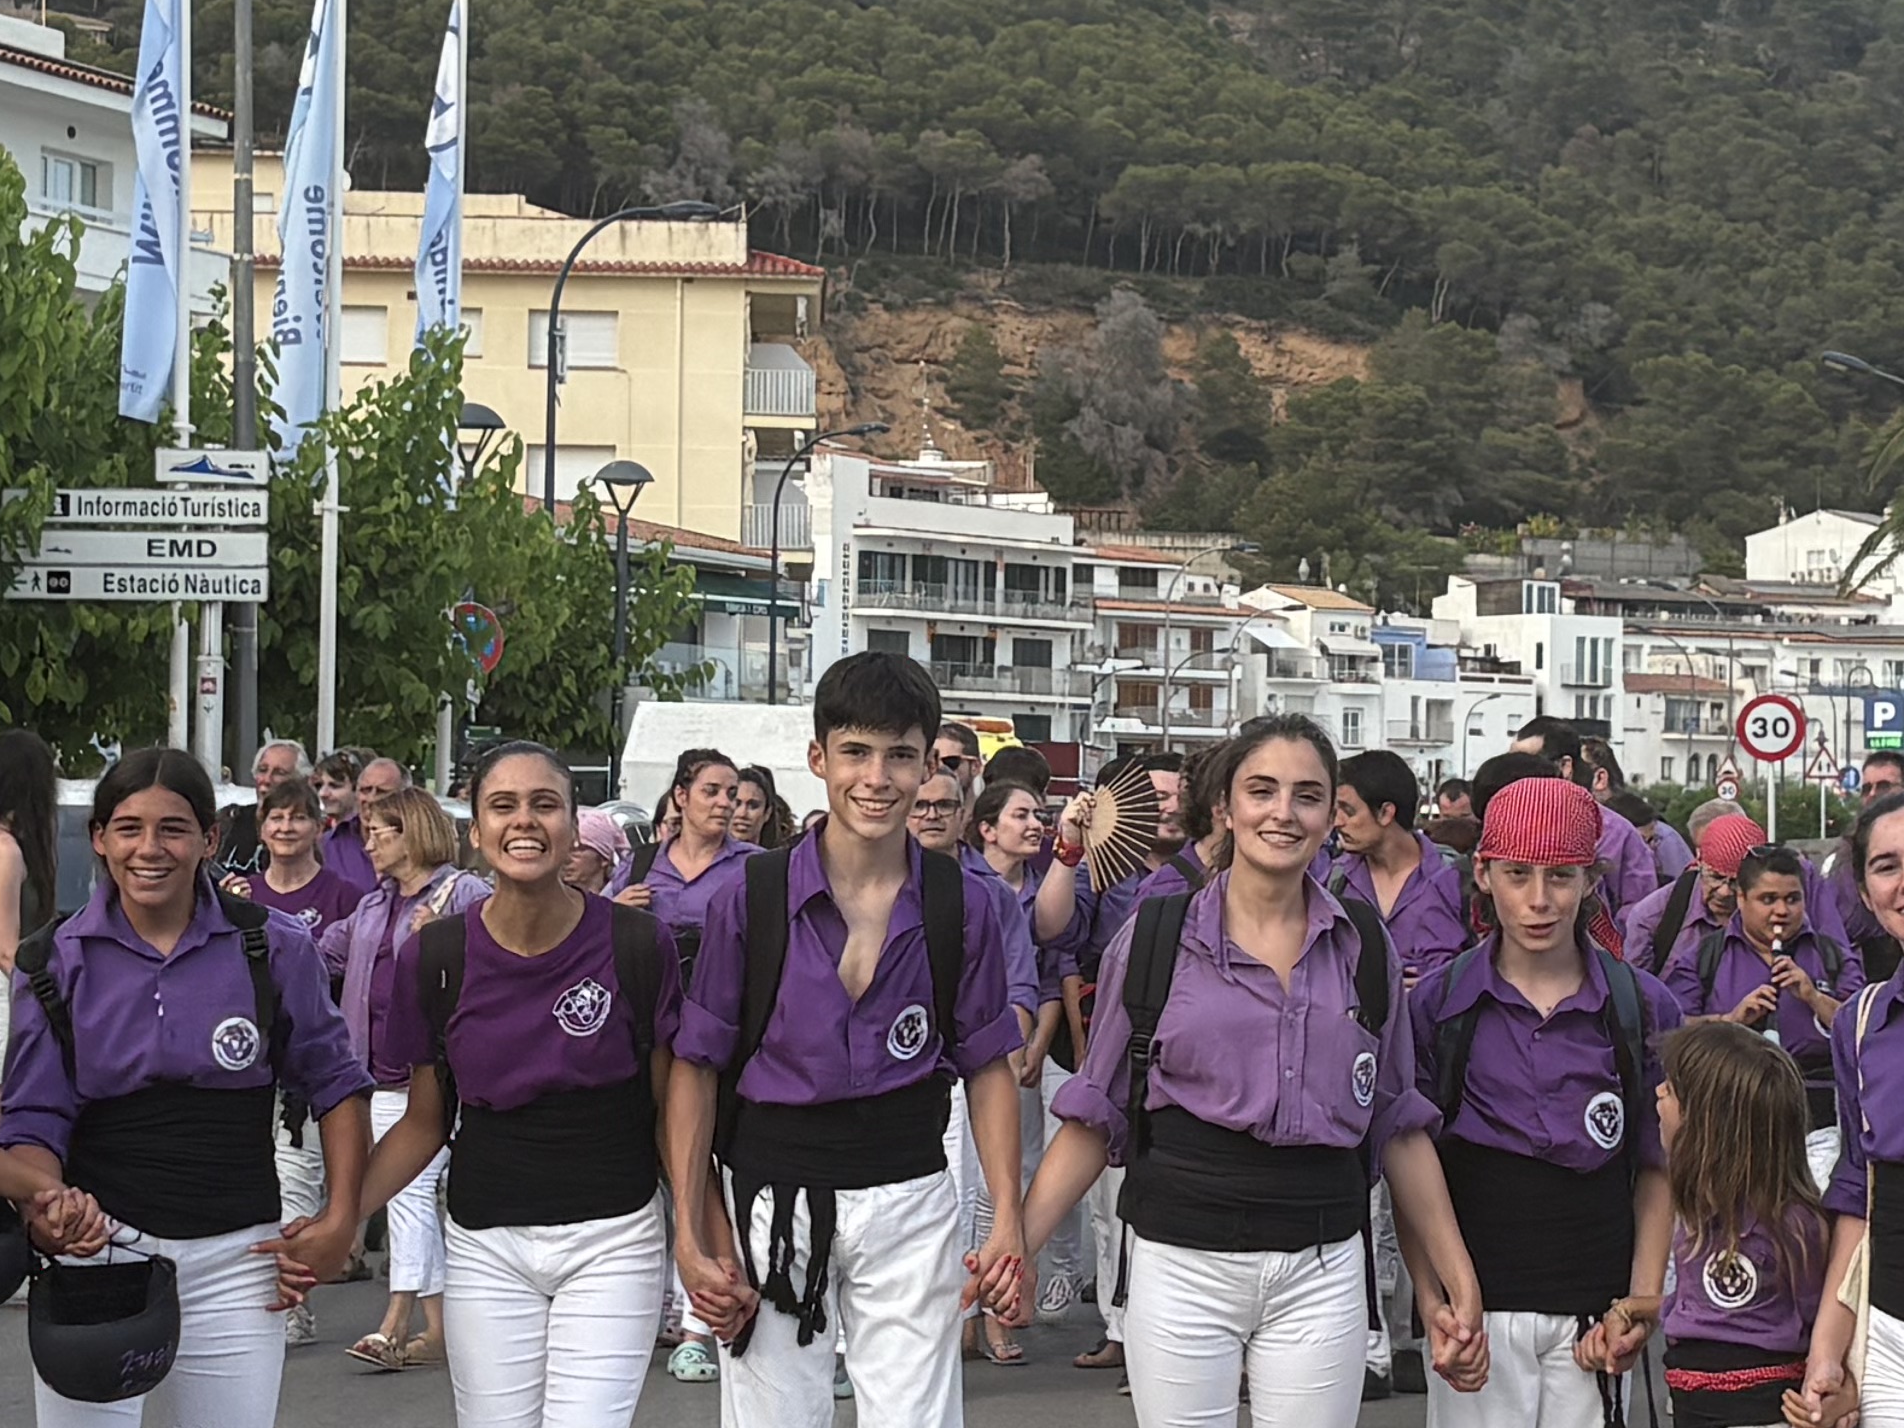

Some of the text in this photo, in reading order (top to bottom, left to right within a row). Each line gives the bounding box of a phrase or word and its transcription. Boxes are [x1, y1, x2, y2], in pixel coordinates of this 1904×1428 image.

[77, 495, 261, 518] Informació Turística
[146, 539, 217, 558] EMD
[102, 572, 261, 595] Estació Nàutica
[1873, 702, 1895, 728] P
[1752, 717, 1790, 738] 30
[1721, 786, 1735, 795] 30
